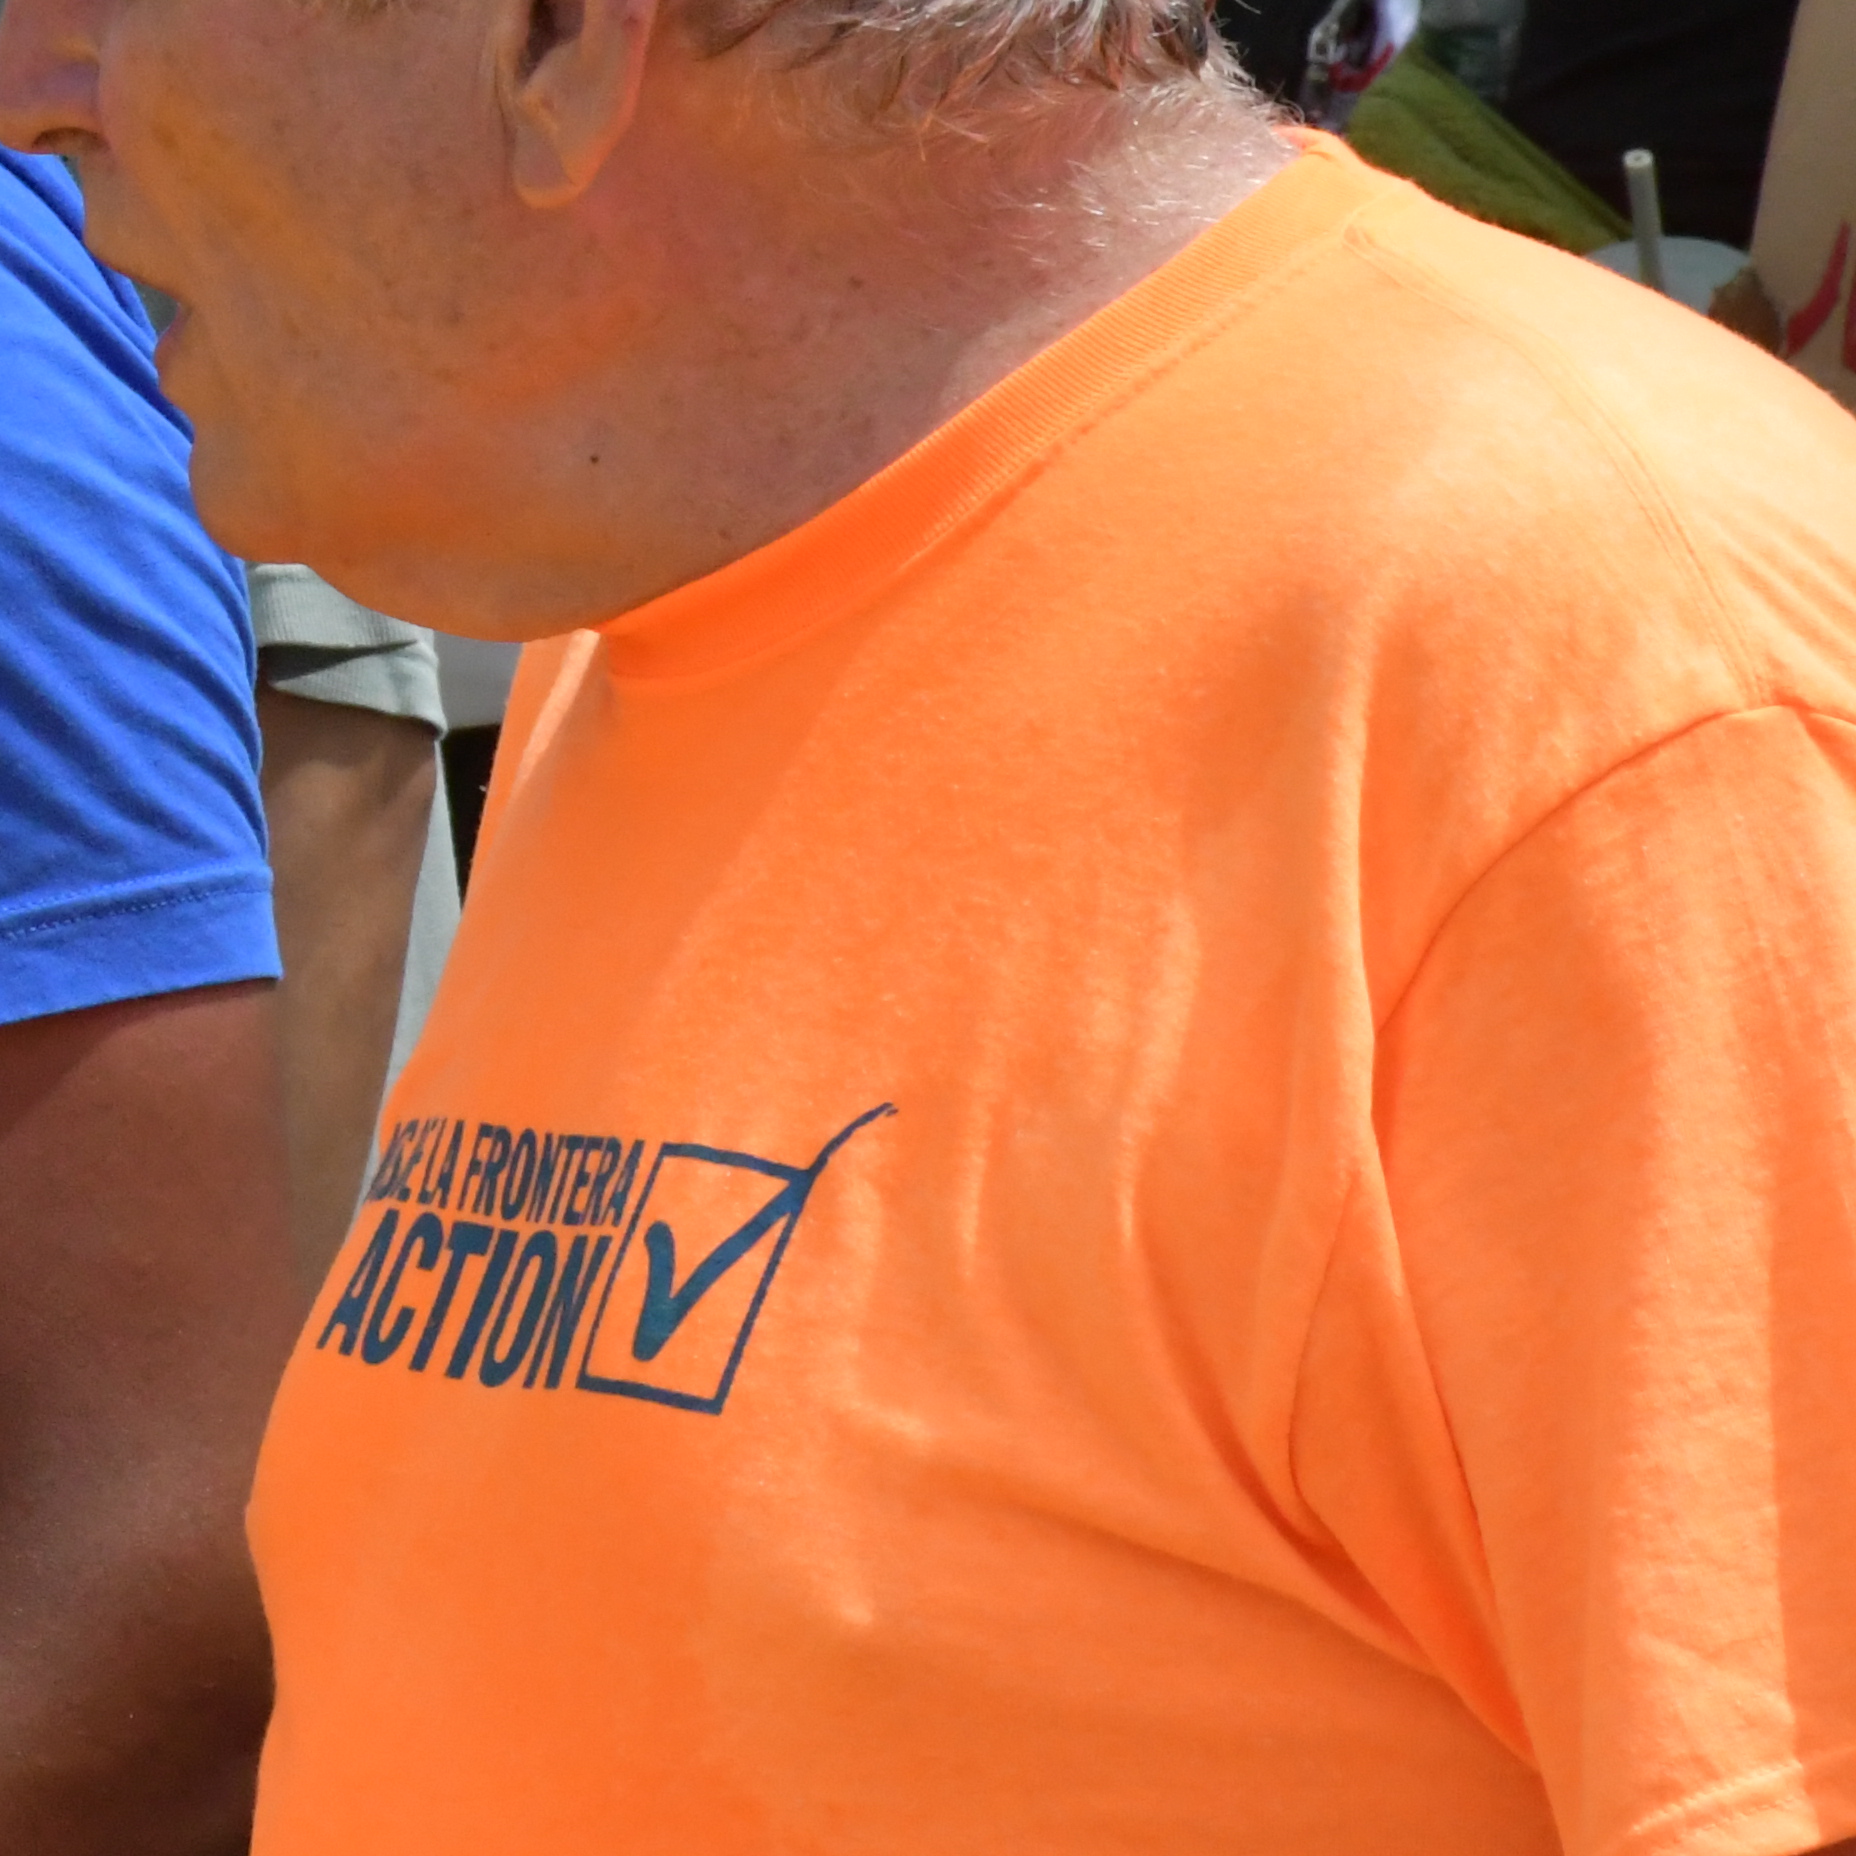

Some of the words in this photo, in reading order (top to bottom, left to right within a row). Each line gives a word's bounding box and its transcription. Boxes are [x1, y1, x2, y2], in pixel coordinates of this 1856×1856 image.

[416, 1116, 466, 1210] LA
[457, 1121, 645, 1228] FRONTERA
[315, 1208, 614, 1391] ACTION
